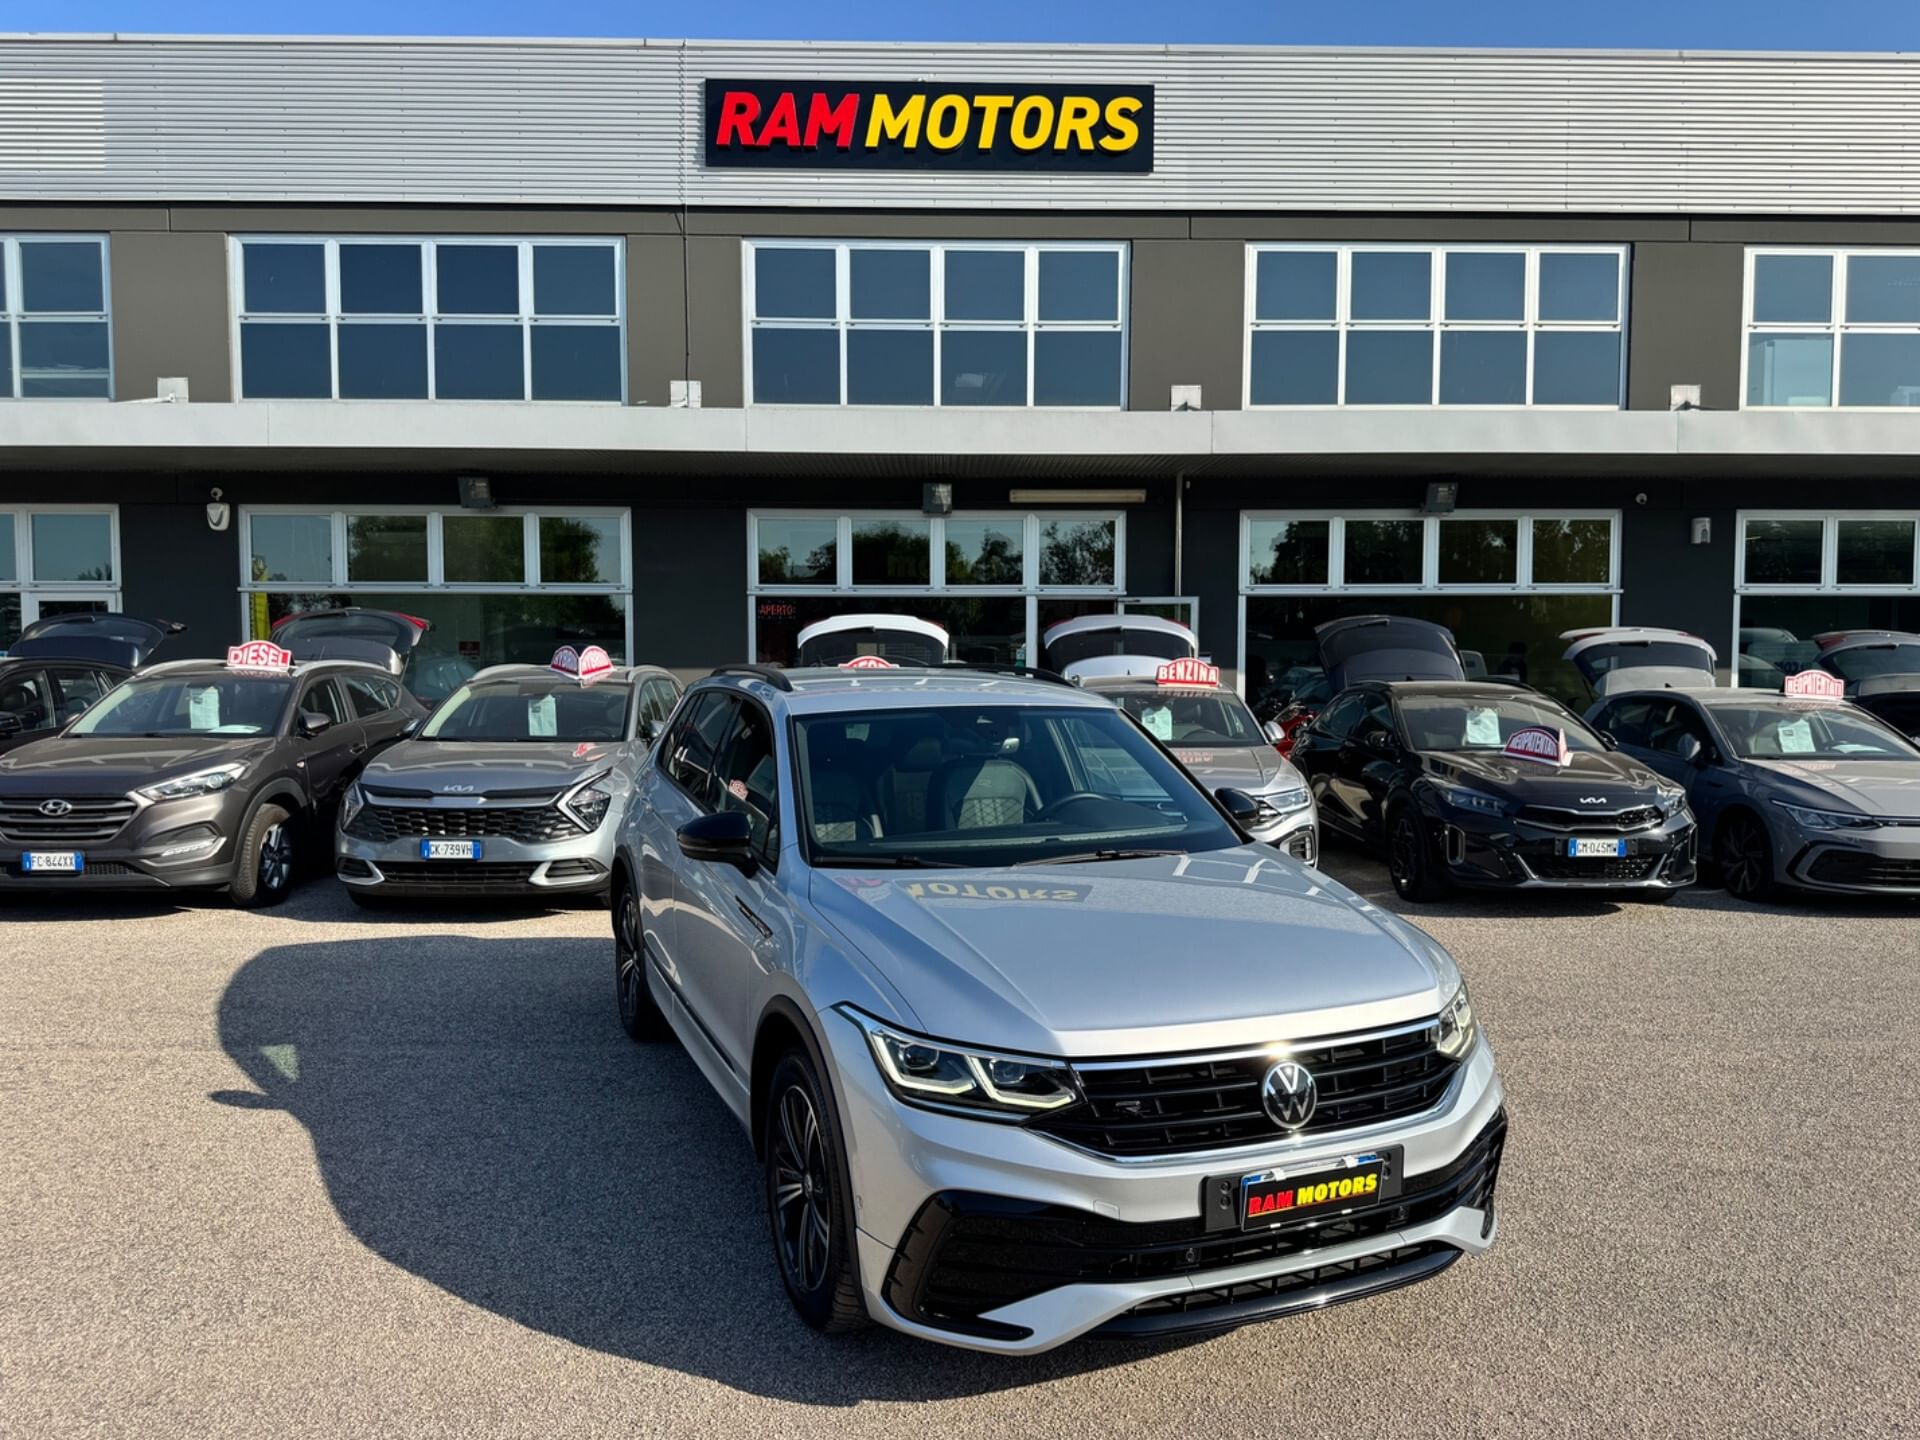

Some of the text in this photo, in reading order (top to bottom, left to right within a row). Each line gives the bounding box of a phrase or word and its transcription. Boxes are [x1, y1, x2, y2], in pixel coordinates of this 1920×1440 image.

[716, 91, 1144, 152] RAM MOTORS
[230, 644, 290, 666] DIESEL
[1158, 660, 1218, 683] BENZINA
[1247, 1172, 1378, 1214] RAM MOTORS
